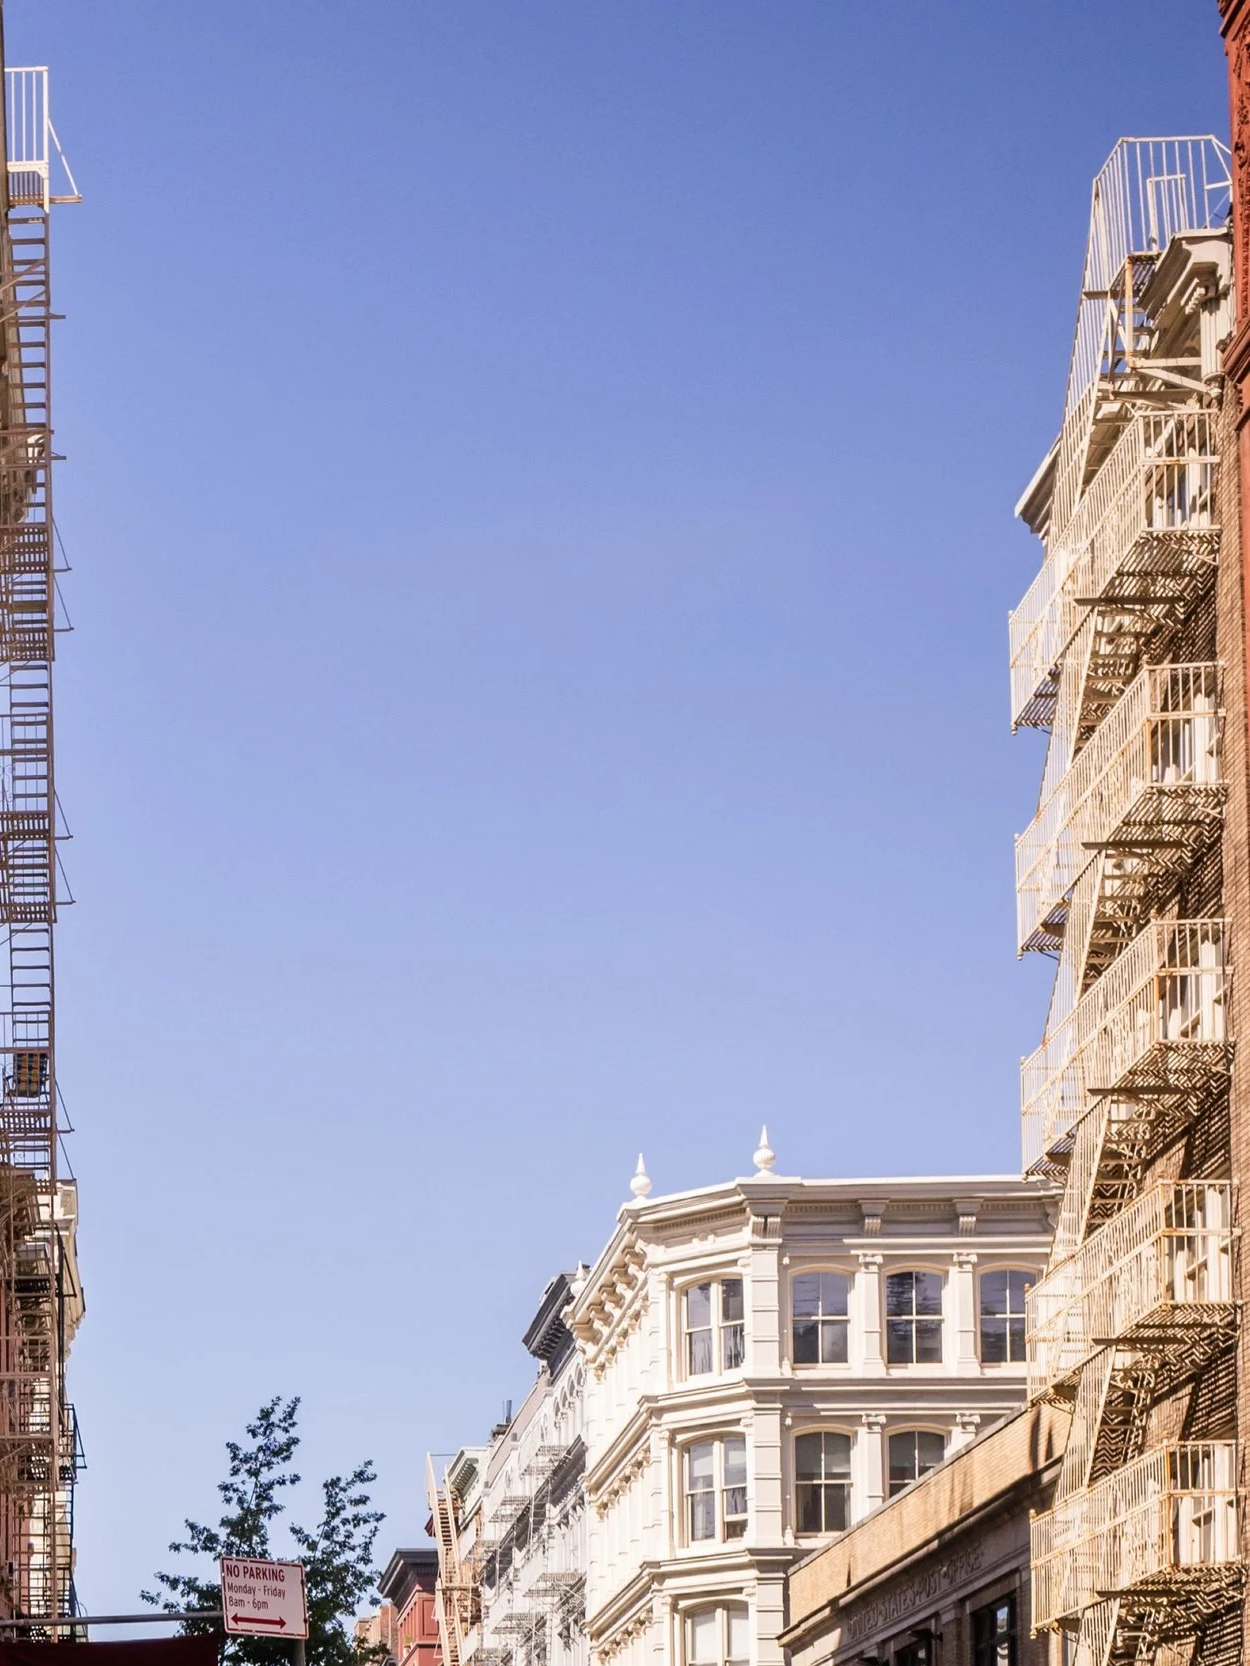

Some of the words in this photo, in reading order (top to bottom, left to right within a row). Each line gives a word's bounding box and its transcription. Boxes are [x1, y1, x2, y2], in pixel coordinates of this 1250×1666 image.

[226, 1564, 240, 1577] NO
[243, 1566, 285, 1582] PARKING
[227, 1582, 256, 1596] Monday
[263, 1586, 286, 1600] Friday
[228, 1596, 245, 1608] 8am
[252, 1598, 269, 1611] 6pm
